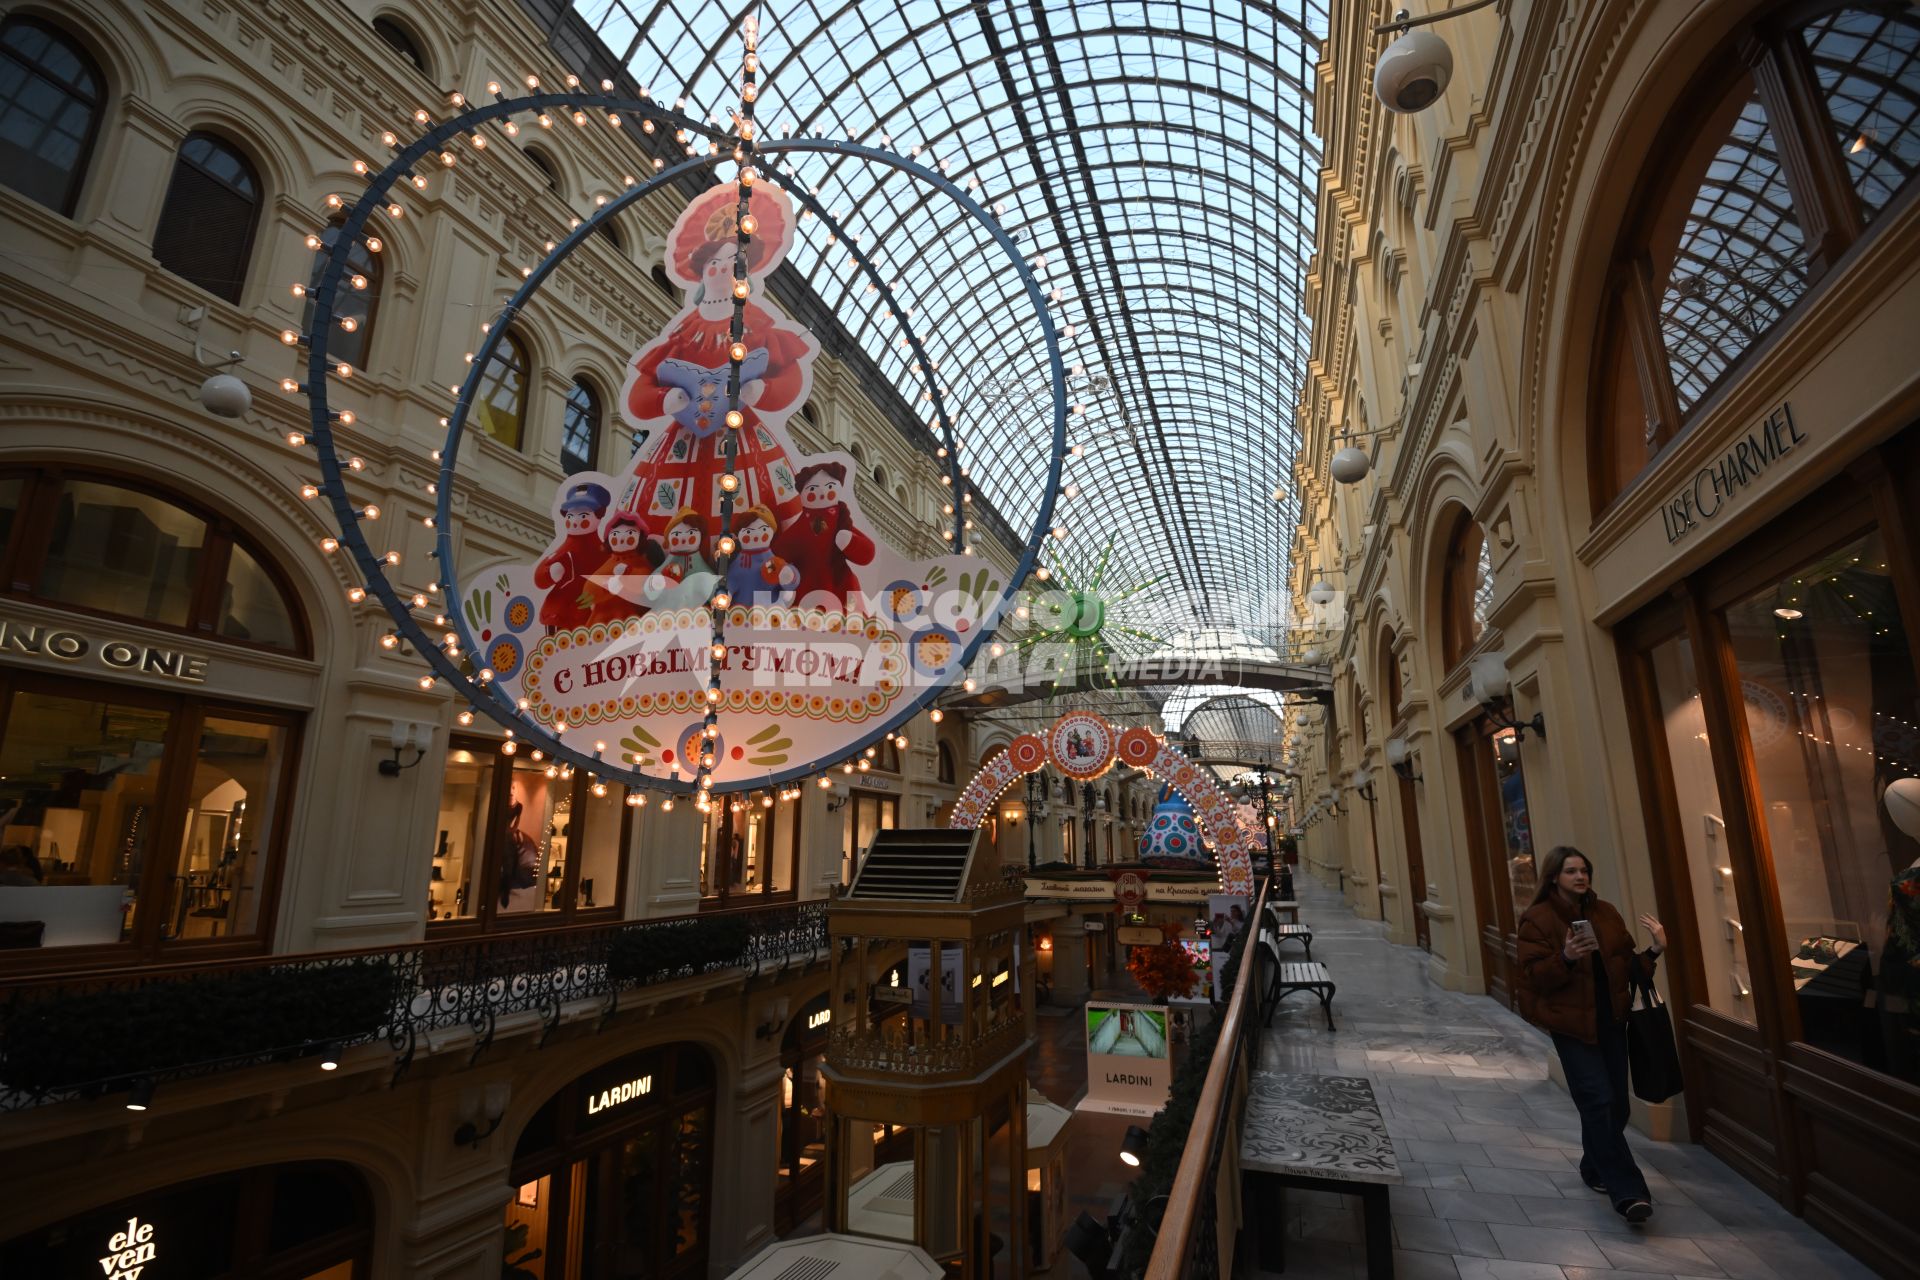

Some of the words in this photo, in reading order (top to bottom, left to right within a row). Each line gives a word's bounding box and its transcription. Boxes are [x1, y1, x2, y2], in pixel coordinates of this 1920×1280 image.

[1661, 489, 1697, 544] LISE
[1695, 402, 1807, 518] CHARMEL
[0, 621, 90, 659] NO
[101, 641, 210, 683] ONE
[553, 669, 573, 694] С
[583, 645, 709, 688] НОВЫМ
[716, 643, 866, 685] ГУМОМ!
[1167, 885, 1199, 896] Красной
[808, 1008, 832, 1029] LARD
[588, 1074, 653, 1115] LARDINI
[1106, 1073, 1152, 1087] LARDINI
[108, 1216, 154, 1252] ele
[98, 1242, 157, 1276] ven
